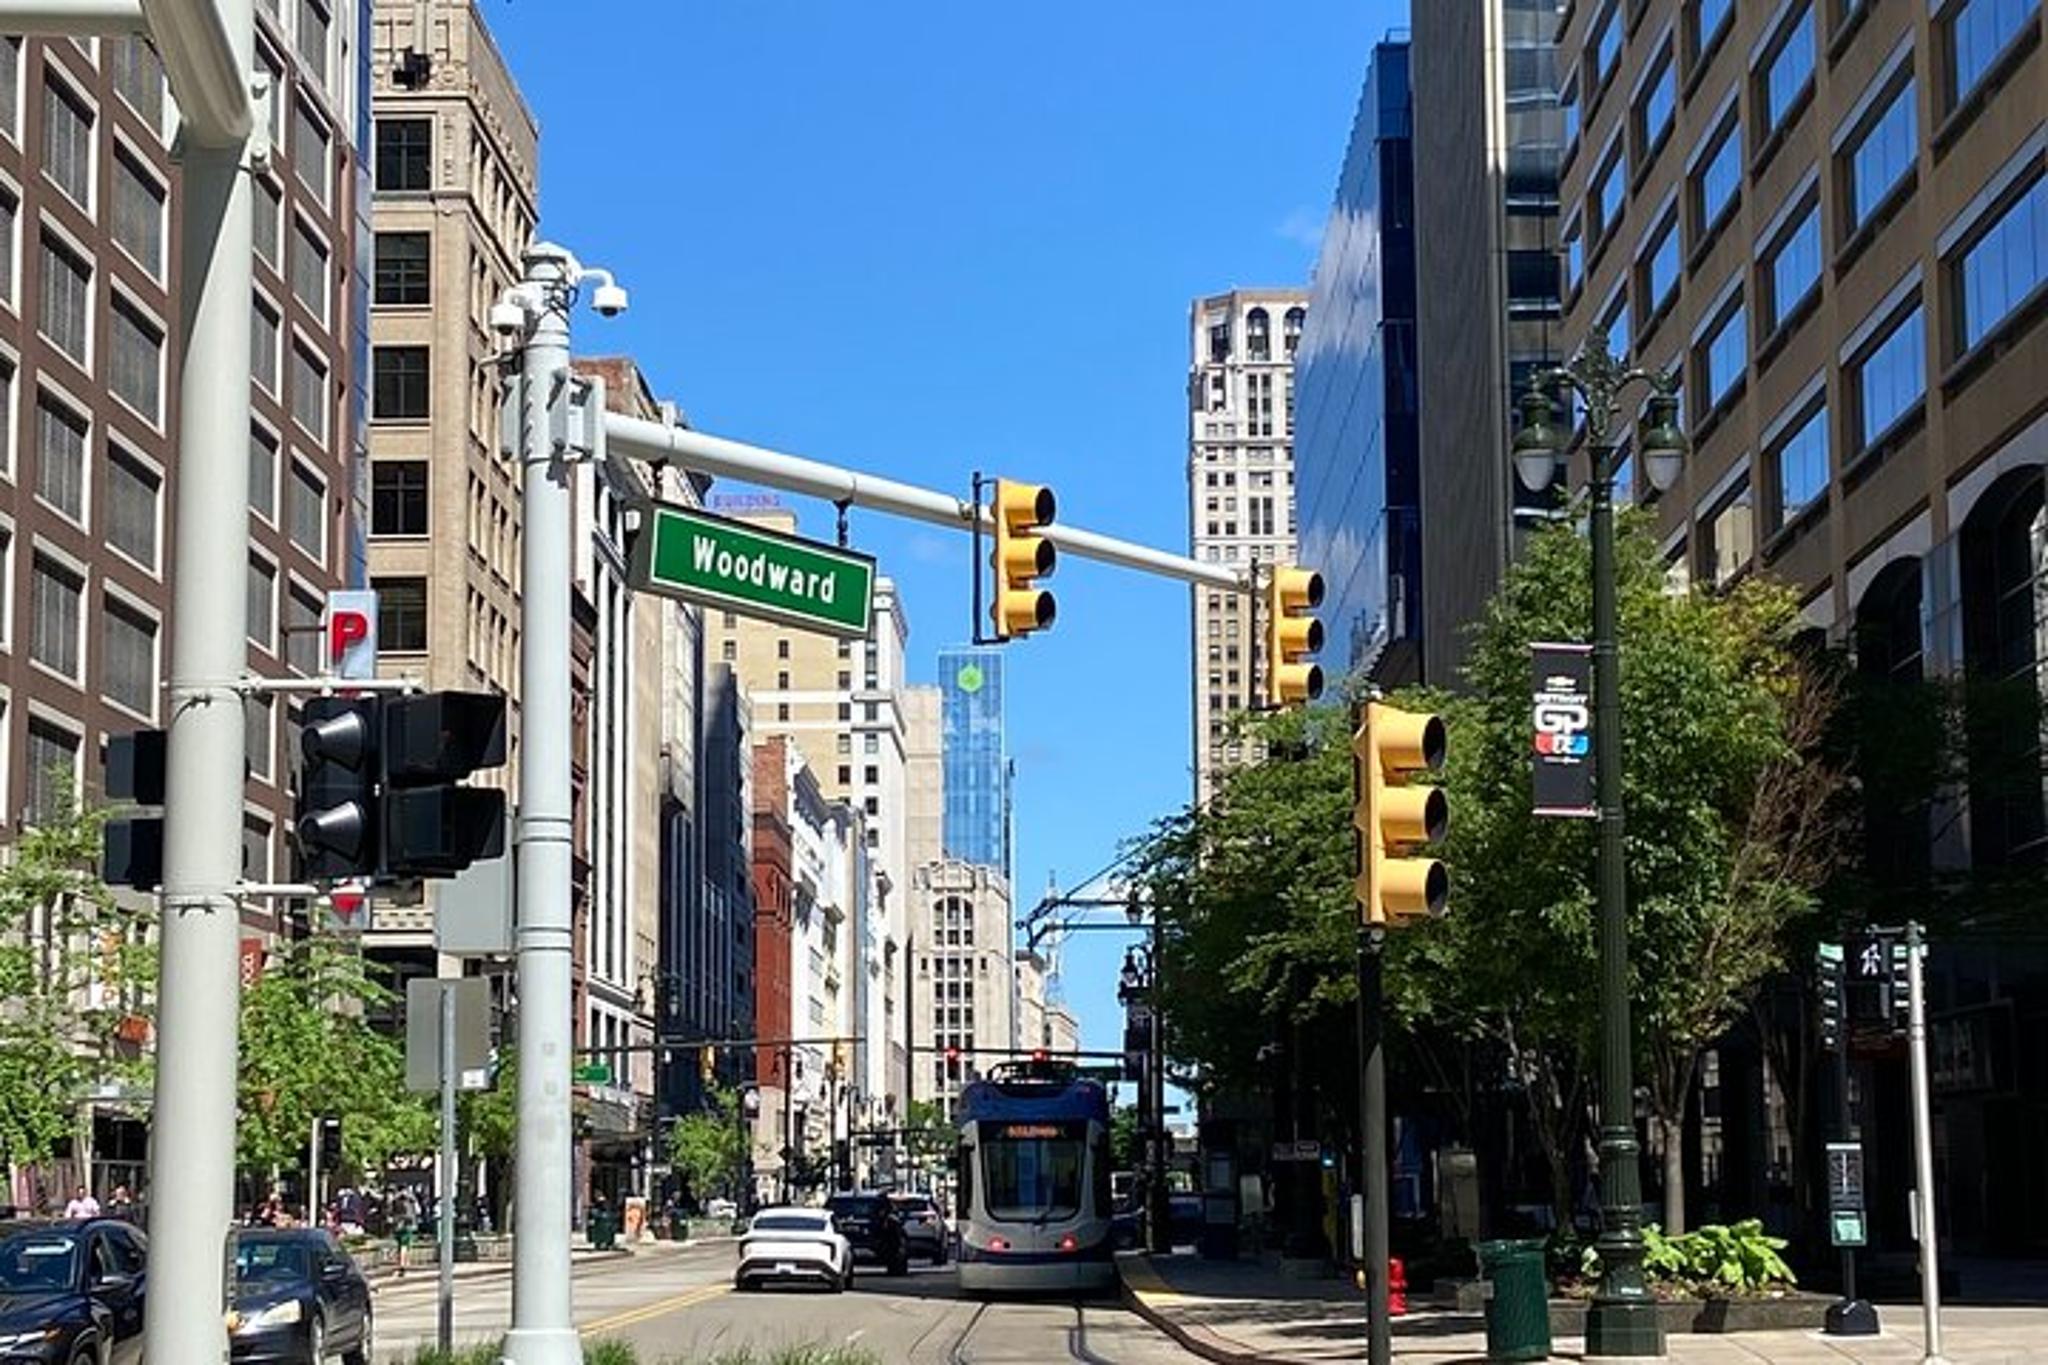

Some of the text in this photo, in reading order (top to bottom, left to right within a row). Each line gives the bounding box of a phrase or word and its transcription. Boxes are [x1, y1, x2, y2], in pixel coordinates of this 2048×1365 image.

[693, 534, 836, 604] Woodward
[332, 611, 368, 666] P
[1534, 704, 1589, 735] GP
